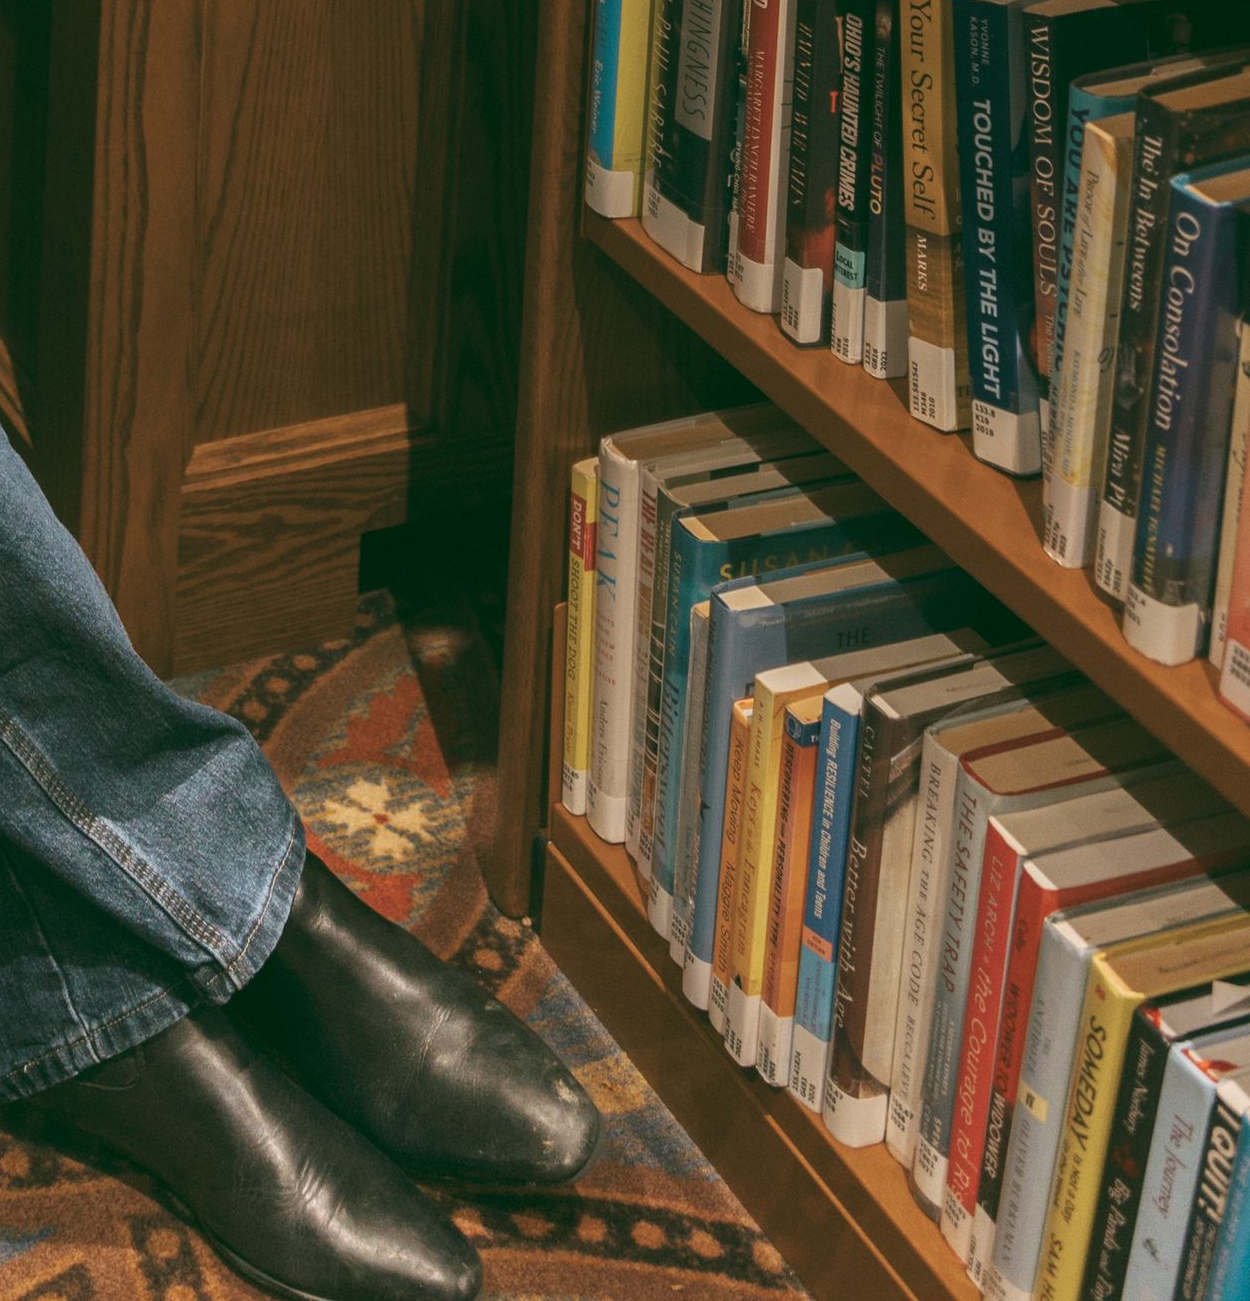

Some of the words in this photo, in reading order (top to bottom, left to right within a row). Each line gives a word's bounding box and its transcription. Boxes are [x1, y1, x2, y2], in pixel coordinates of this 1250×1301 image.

[844, 12, 863, 72] OHIO'S
[875, 47, 886, 68] THE
[980, 18, 990, 67] YVONNE
[593, 58, 603, 85] Eric
[751, 50, 766, 126] MARGARET
[971, 59, 980, 88] M.D.
[1030, 25, 1053, 146] WISDOM
[589, 89, 601, 134] Weiner
[649, 82, 672, 169] SARTRE
[840, 68, 861, 146] HAUNTED
[872, 69, 886, 136] TWILIGHT
[910, 69, 934, 151] Secret
[749, 126, 762, 171] LYNCH
[871, 136, 883, 150] OF
[973, 98, 995, 222] TOUCHED
[1068, 107, 1090, 170] YOU
[1141, 135, 1163, 175] The
[837, 147, 858, 212] CRIMES
[869, 151, 884, 216] PLUTO
[911, 160, 936, 221] Self
[1034, 155, 1054, 197] OF
[1084, 170, 1100, 218] PROOF
[1138, 177, 1159, 201] In
[745, 174, 757, 234] RANIERE
[1061, 181, 1081, 236] ARE
[976, 227, 997, 264] BY
[1037, 201, 1058, 304] SOULS
[1173, 211, 1200, 258] On
[916, 234, 929, 293] MARKS
[1129, 207, 1156, 313] Betweens
[978, 267, 998, 318] THE
[1073, 287, 1088, 318] LIFE
[981, 321, 1000, 400] LIGHT
[1154, 264, 1197, 432] Consolation
[975, 403, 996, 418] 133.8
[1110, 429, 1132, 479] Mira
[1149, 443, 1167, 512] MICHAEL
[570, 498, 582, 551] DON'T
[596, 480, 621, 601] PEAK
[569, 557, 581, 613] SHOOT
[669, 550, 682, 612] SUSAN
[568, 613, 579, 643] THE
[669, 614, 680, 657] CAIN
[836, 628, 872, 649] THE
[566, 645, 578, 681] DOG
[598, 697, 610, 740] Anders
[826, 718, 842, 759] Building
[731, 737, 745, 781] Keep
[779, 741, 795, 824] DISCOVERING
[822, 759, 839, 819] RESILIENCE
[921, 761, 942, 865] BREAKING
[725, 782, 743, 847] Moving
[822, 818, 831, 830] in
[959, 793, 978, 841] THE
[818, 830, 832, 870] Children
[845, 836, 868, 914] Better
[989, 855, 1003, 886] LIZ
[720, 861, 737, 920] Maggie
[772, 837, 787, 914] PERSONALITY
[816, 870, 826, 890] and
[919, 866, 931, 904] THE
[949, 842, 971, 925] SAFETY
[813, 892, 829, 919] Teens
[913, 909, 928, 946] AGE
[983, 892, 999, 951] ARCH
[718, 922, 731, 973] Smith
[769, 917, 781, 947] TYPE
[907, 953, 924, 1009] CODE
[940, 932, 961, 995] TRAP
[834, 979, 854, 1029] Age
[973, 965, 993, 1014] the
[902, 1015, 916, 1060] BECCA
[1000, 982, 1021, 1068] WIDOWER
[899, 1061, 911, 1099] LEVY
[962, 1017, 989, 1127] Courage
[1071, 1014, 1107, 1153] SOMEDAY
[1136, 1038, 1156, 1079] James
[1122, 1078, 1149, 1136] Norbury
[1168, 1113, 1196, 1151] The
[1218, 1103, 1243, 1130] I
[957, 1129, 973, 1166] to
[983, 1091, 1006, 1179] WIDOWER
[1108, 1177, 1132, 1206] Big
[1158, 1145, 1188, 1220] Journey
[1197, 1129, 1238, 1224] QUIT!
[1062, 1199, 1075, 1224] Day
[1102, 1205, 1128, 1251] Panda
[1045, 1232, 1065, 1278] SAM
